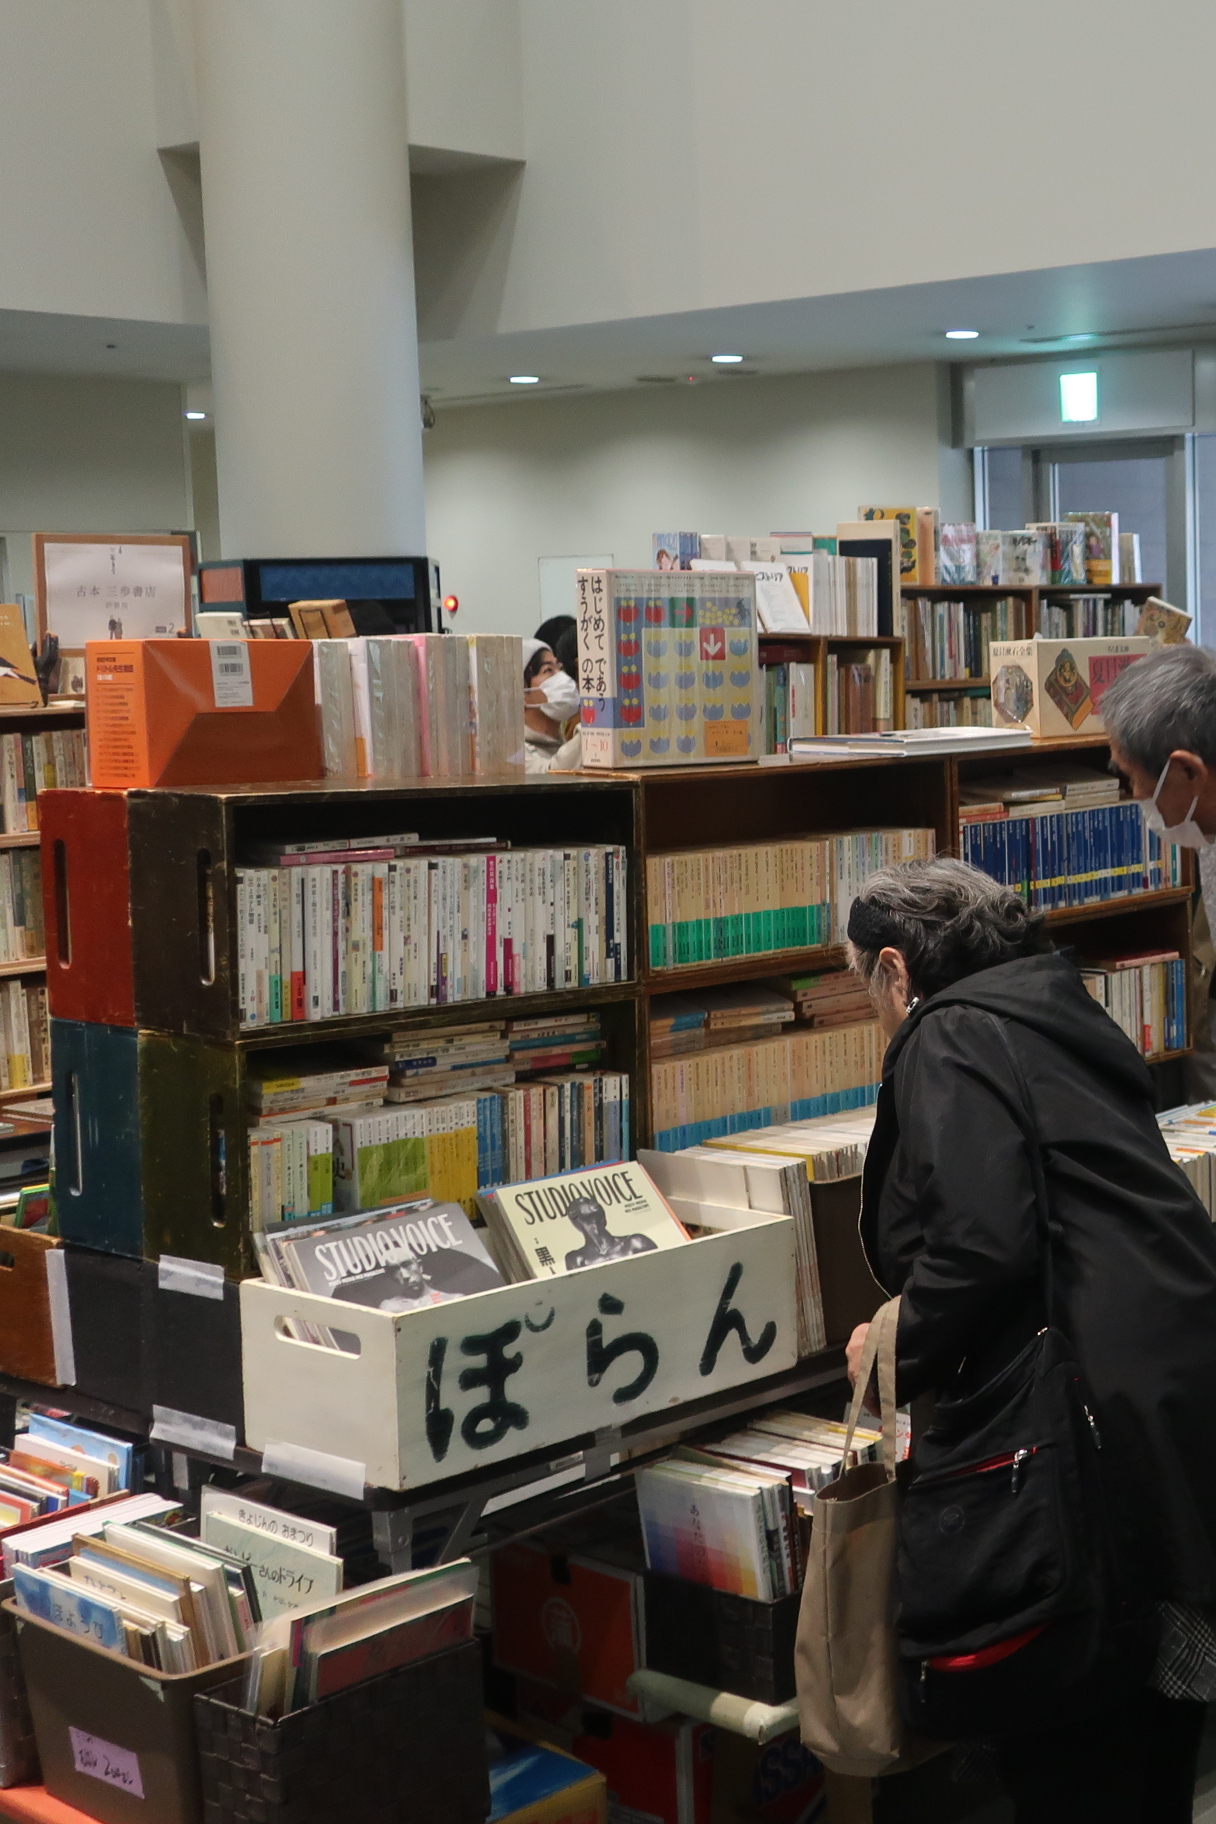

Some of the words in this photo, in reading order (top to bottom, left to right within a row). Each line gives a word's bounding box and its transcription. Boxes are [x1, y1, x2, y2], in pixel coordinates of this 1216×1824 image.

[577, 576, 593, 651] すうがく
[591, 576, 606, 651] はじめて
[582, 658, 595, 694] の本
[594, 658, 608, 713] であう
[514, 1180, 583, 1226] STUDIO
[580, 1170, 643, 1207] VOICE
[314, 1228, 396, 1281] STUDIO
[390, 1213, 463, 1255] VOICE
[237, 1508, 279, 1535] きょじんの
[281, 1523, 315, 1547] おまつり
